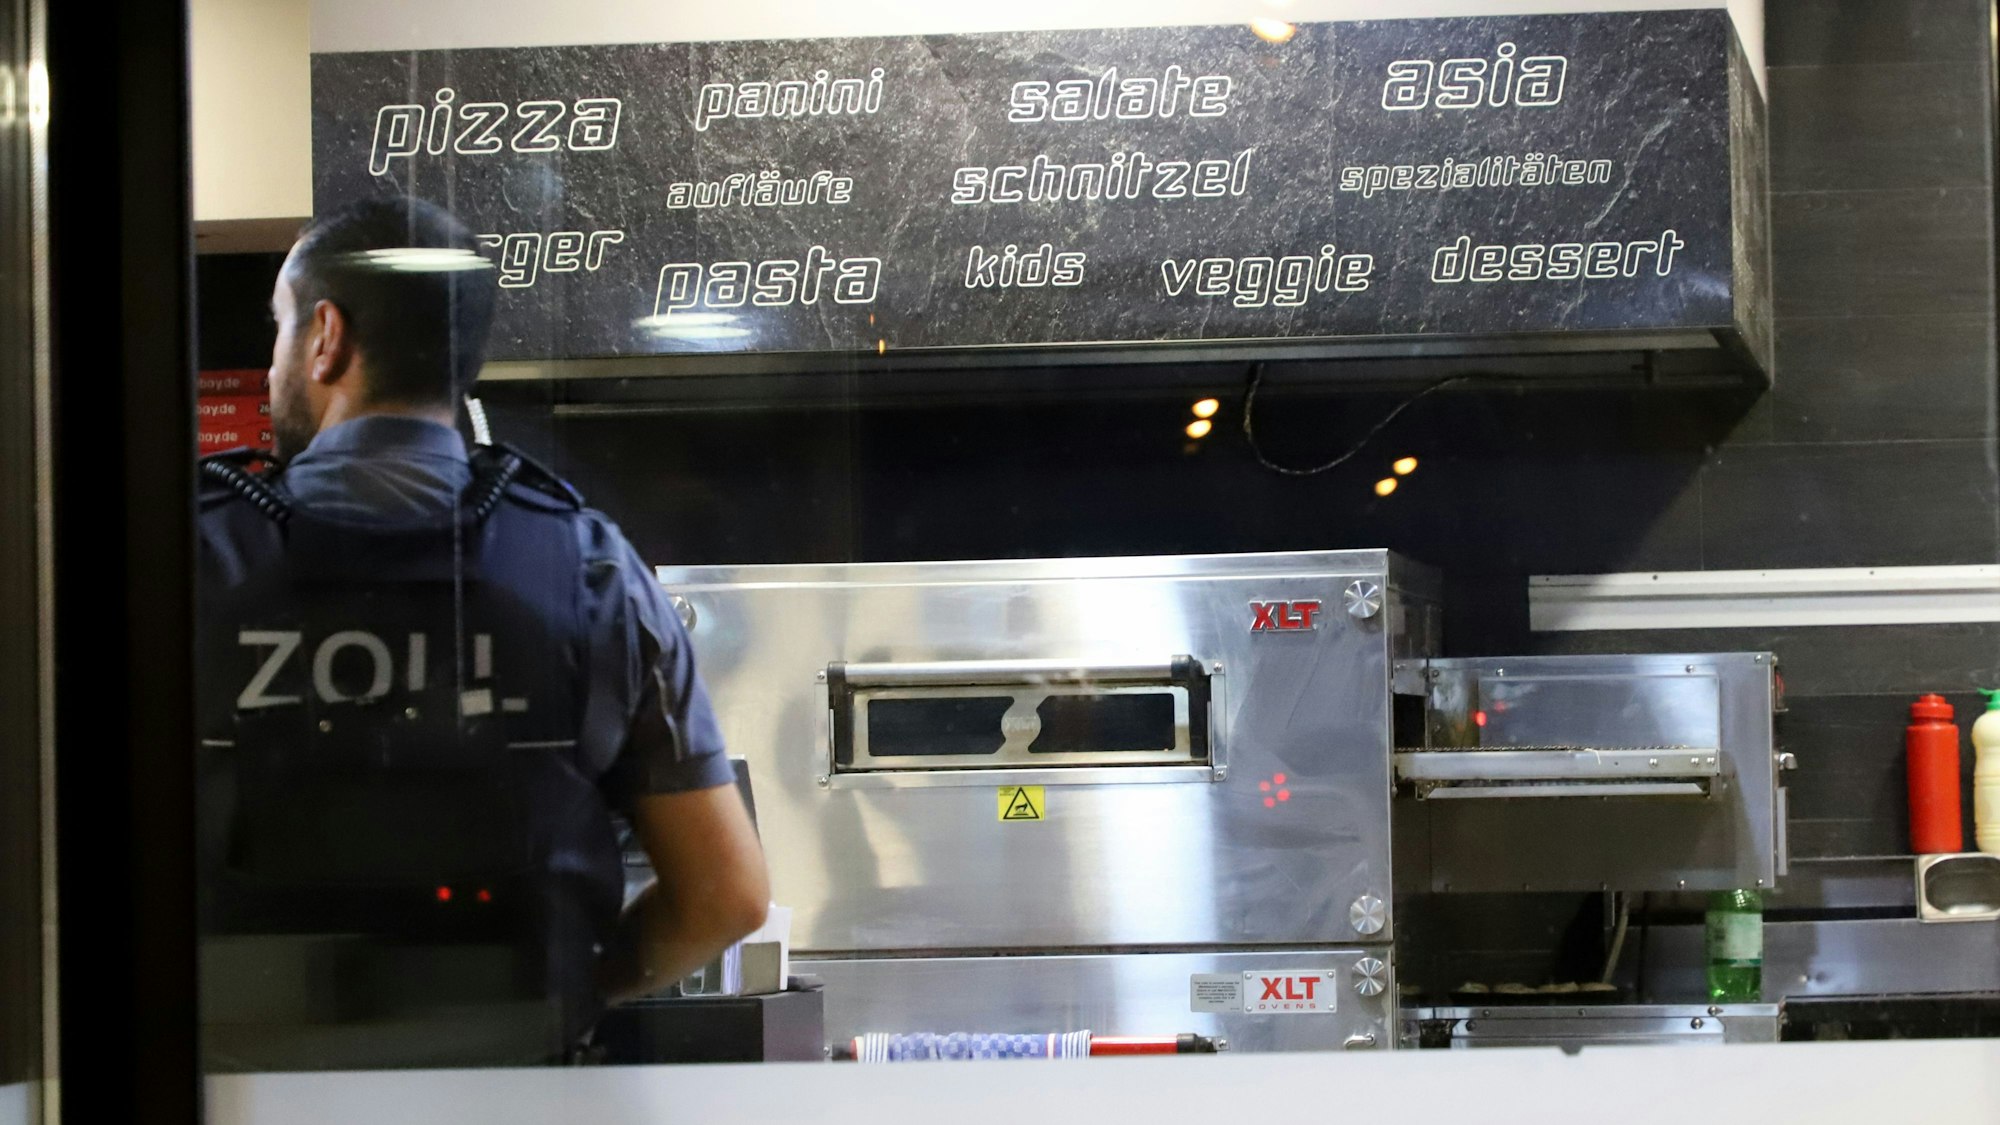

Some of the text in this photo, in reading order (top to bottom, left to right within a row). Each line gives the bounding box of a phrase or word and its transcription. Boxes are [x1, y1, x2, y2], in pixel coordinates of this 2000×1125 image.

[695, 67, 886, 132] panini
[1007, 63, 1232, 124] salate
[1380, 41, 1569, 113] asia
[368, 86, 622, 177] pizza
[666, 169, 854, 210] aufläufe
[949, 148, 1254, 206] schnitzel
[1339, 152, 1613, 197] spezialitäten
[652, 244, 882, 327] pasta
[964, 242, 1087, 289] kids
[1160, 243, 1375, 309] veggie
[1430, 228, 1686, 285] dessert
[1250, 600, 1322, 631] XLT
[1260, 976, 1321, 1000] XLT
